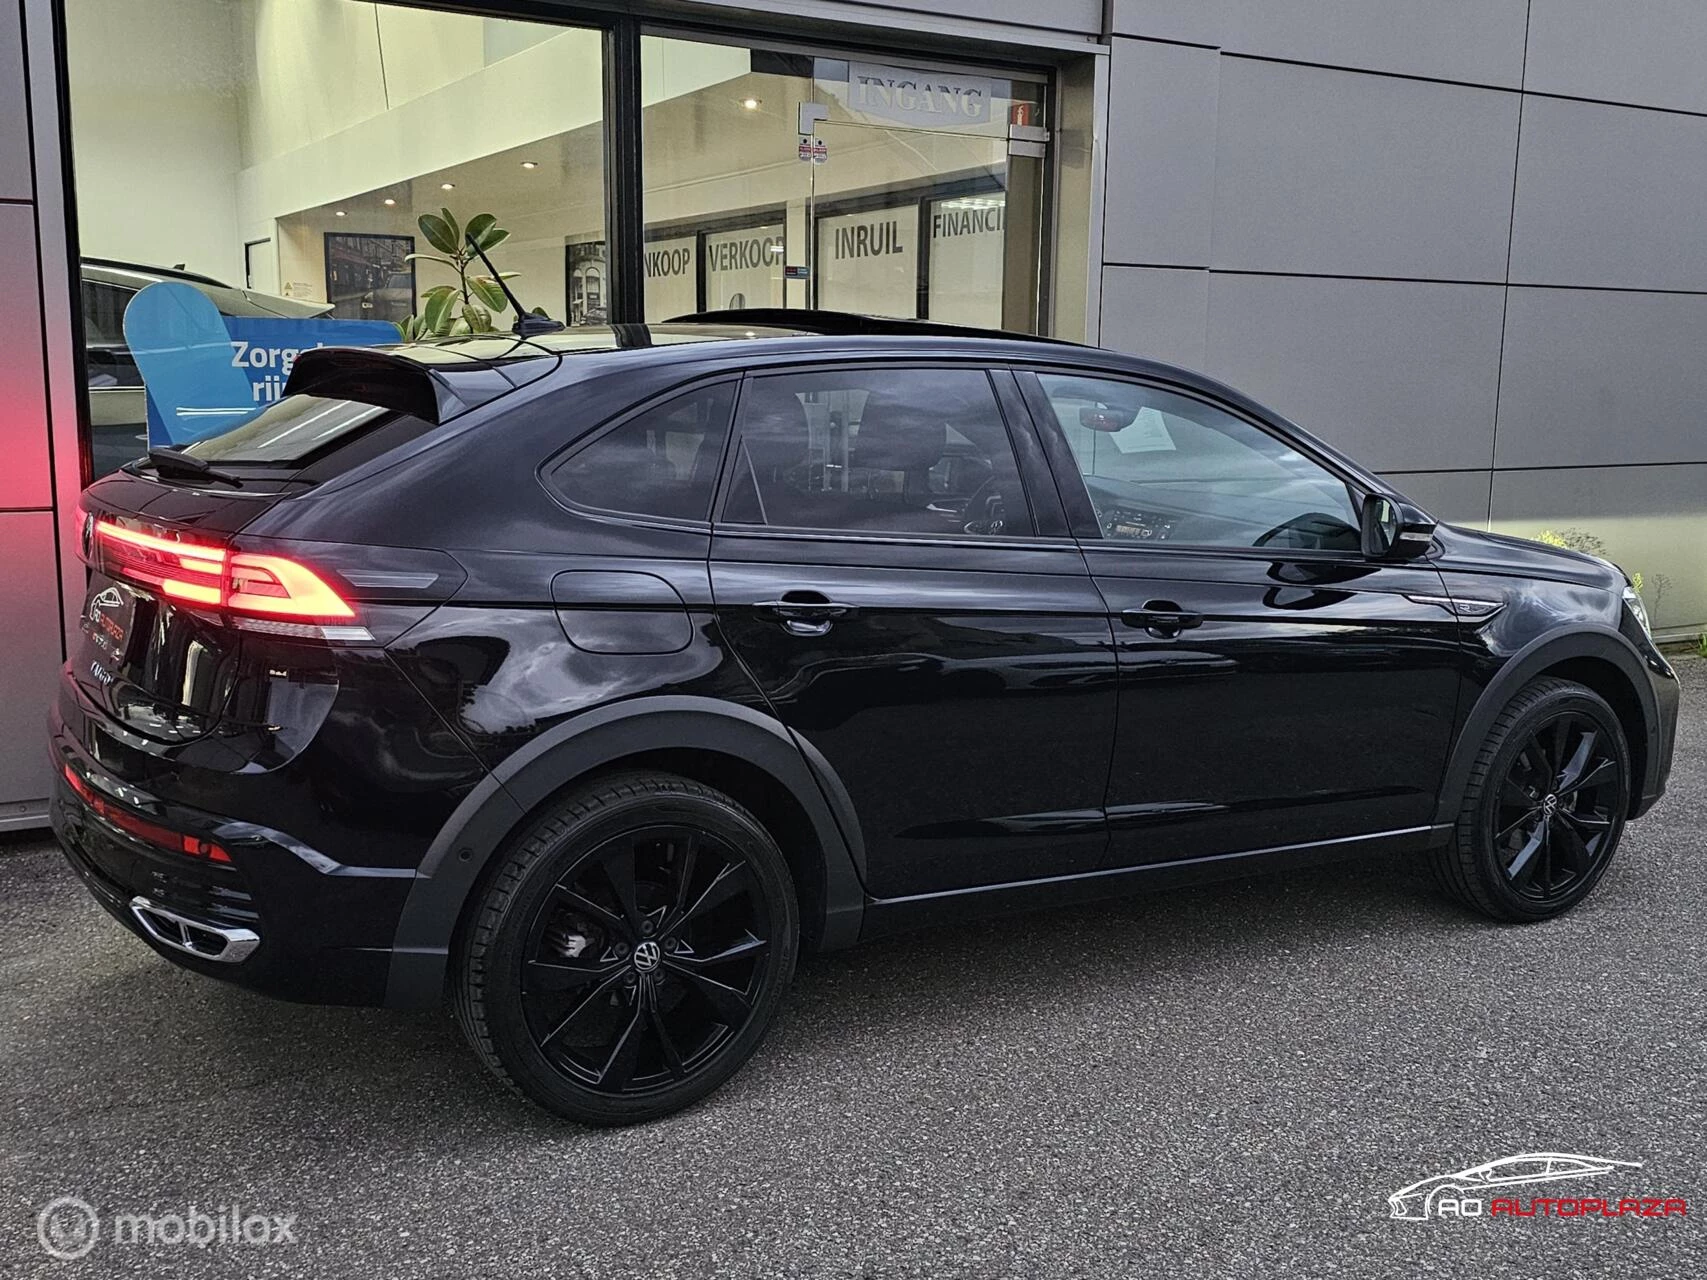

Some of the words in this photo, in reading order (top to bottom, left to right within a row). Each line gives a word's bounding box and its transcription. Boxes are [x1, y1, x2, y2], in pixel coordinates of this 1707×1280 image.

[857, 75, 982, 117] INGANG
[709, 236, 785, 272] VERKOOP
[835, 220, 903, 260] INRUIL
[230, 341, 323, 376] Zorg
[252, 375, 287, 402] rij
